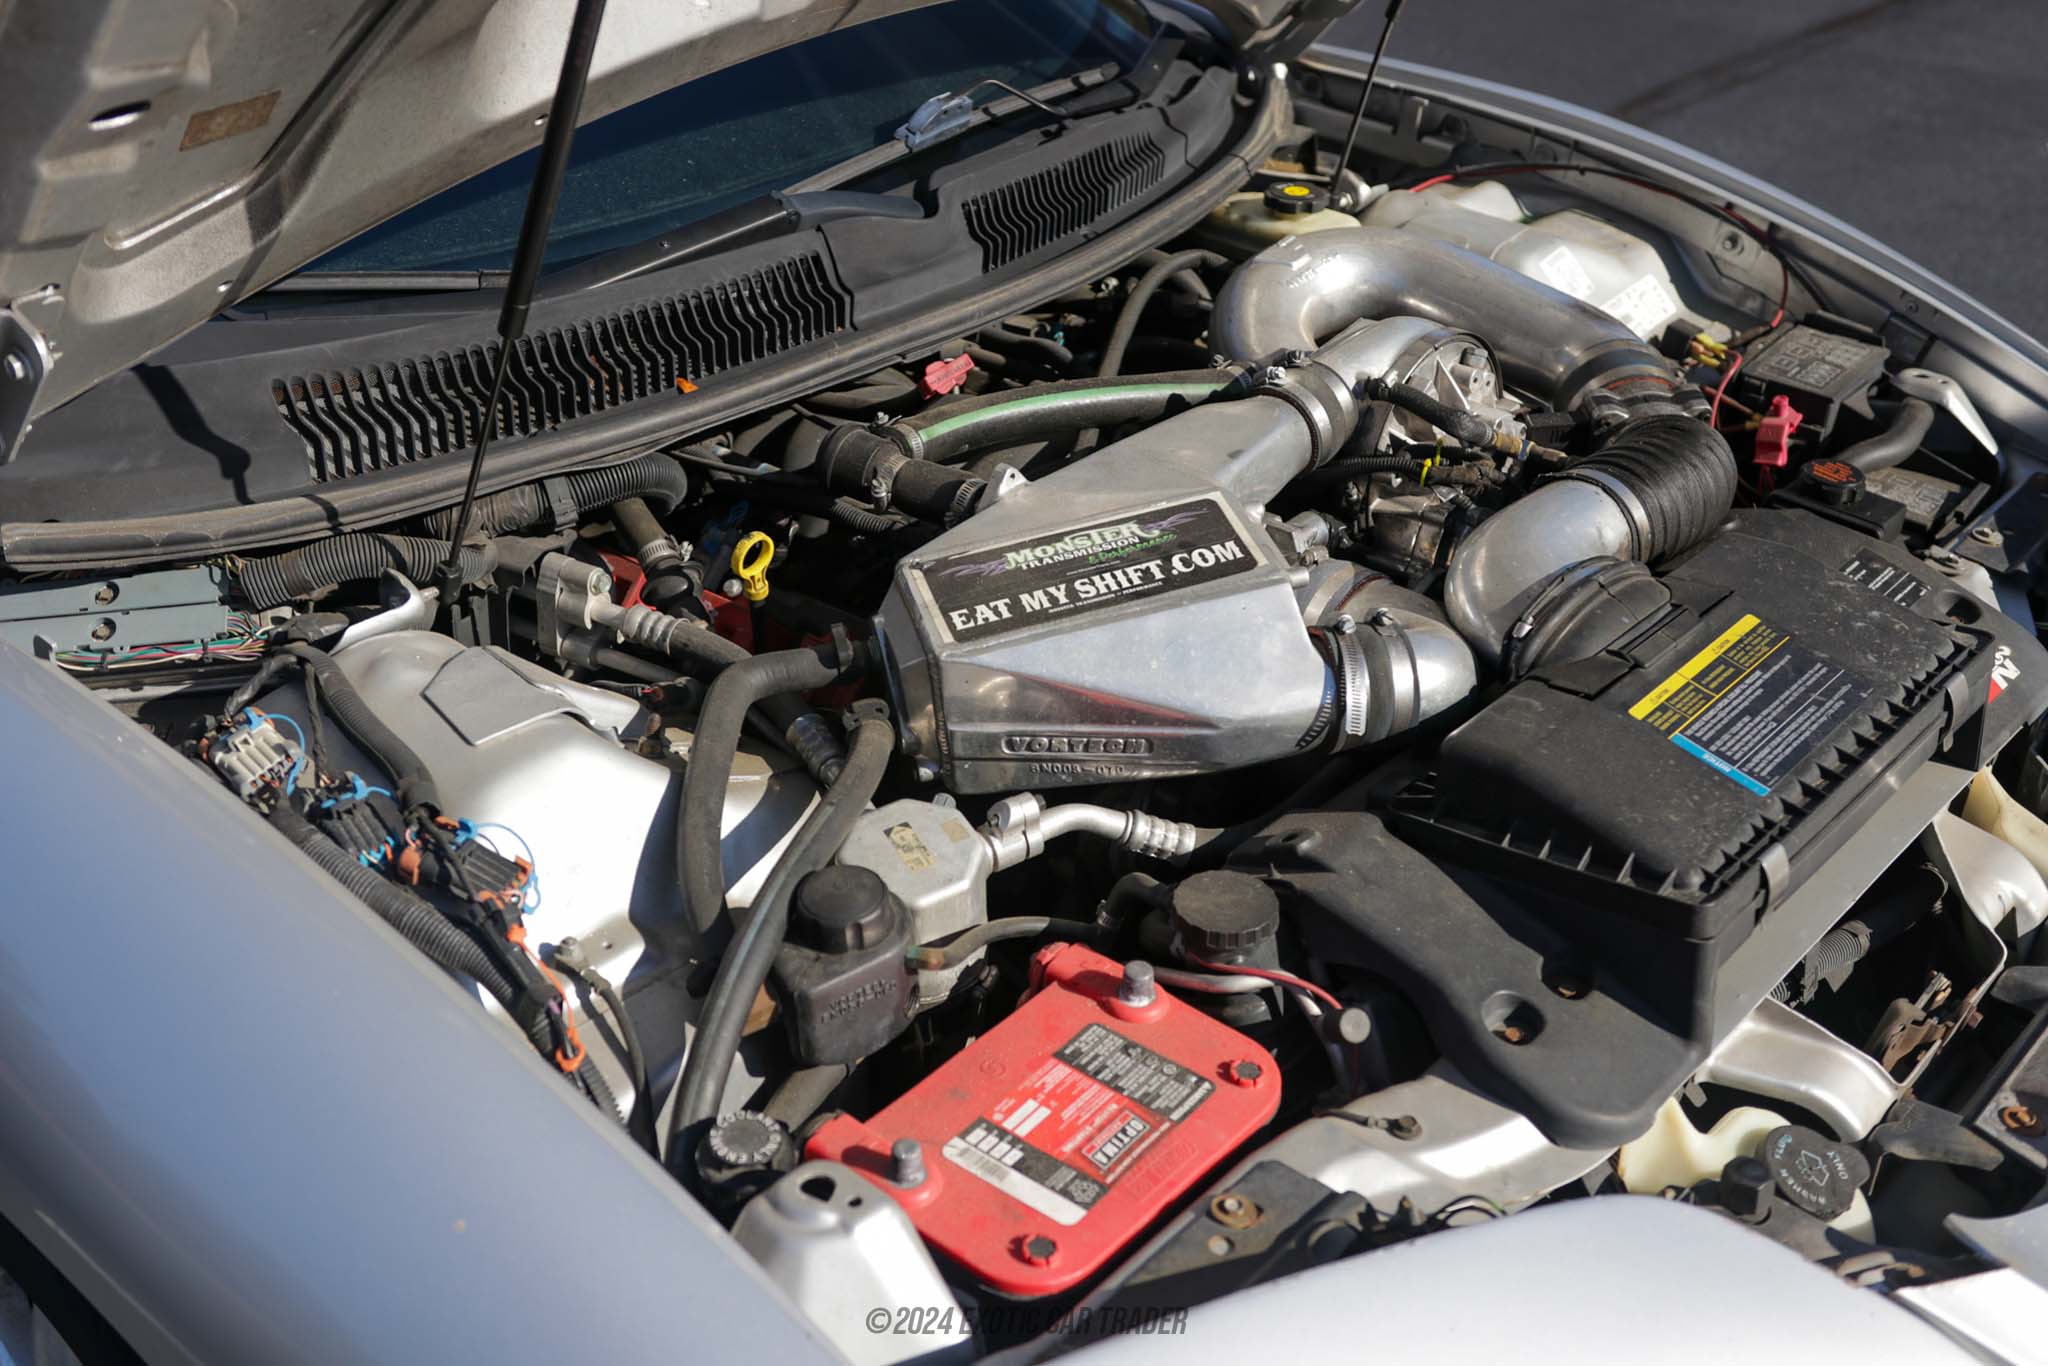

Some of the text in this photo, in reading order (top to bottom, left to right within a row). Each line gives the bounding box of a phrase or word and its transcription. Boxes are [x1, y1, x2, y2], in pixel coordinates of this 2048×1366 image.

[1004, 521, 1161, 570] MONSTER
[1018, 536, 1142, 571] TRANSMISSION
[949, 598, 1012, 632] EAT
[1020, 585, 1071, 614] MY
[1074, 564, 1167, 599] SHIFT
[1011, 737, 1146, 754] VORTECH
[1096, 1119, 1145, 1167] OPTIMA
[1825, 1150, 1849, 1180] ONLY
